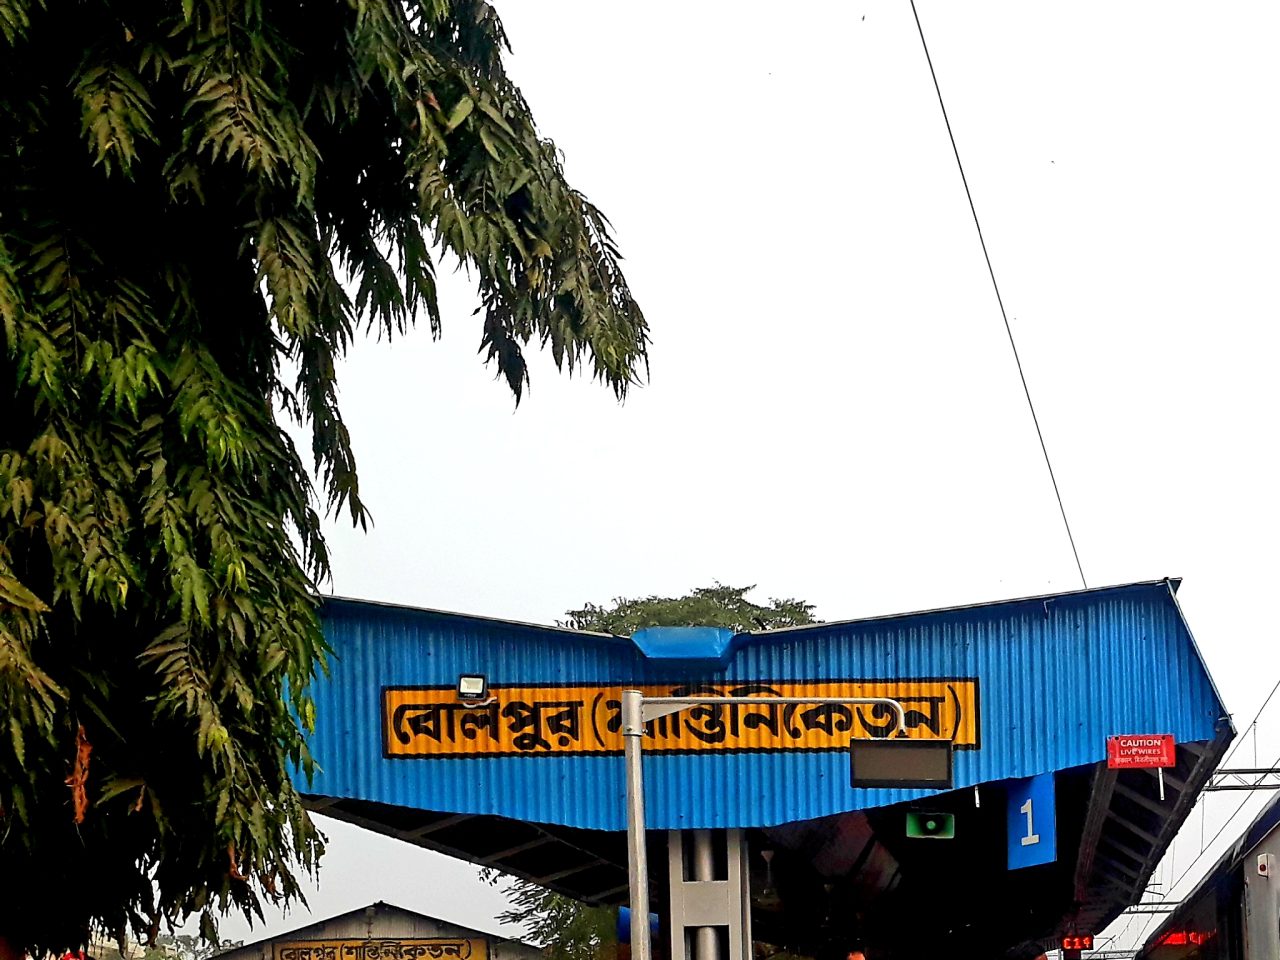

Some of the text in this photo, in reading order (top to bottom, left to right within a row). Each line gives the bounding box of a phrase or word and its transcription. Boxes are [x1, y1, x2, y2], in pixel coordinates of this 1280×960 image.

[393, 700, 585, 751] বোলপুর
[1120, 739, 1161, 747] CAUTION
[1020, 798, 1040, 847] 1
